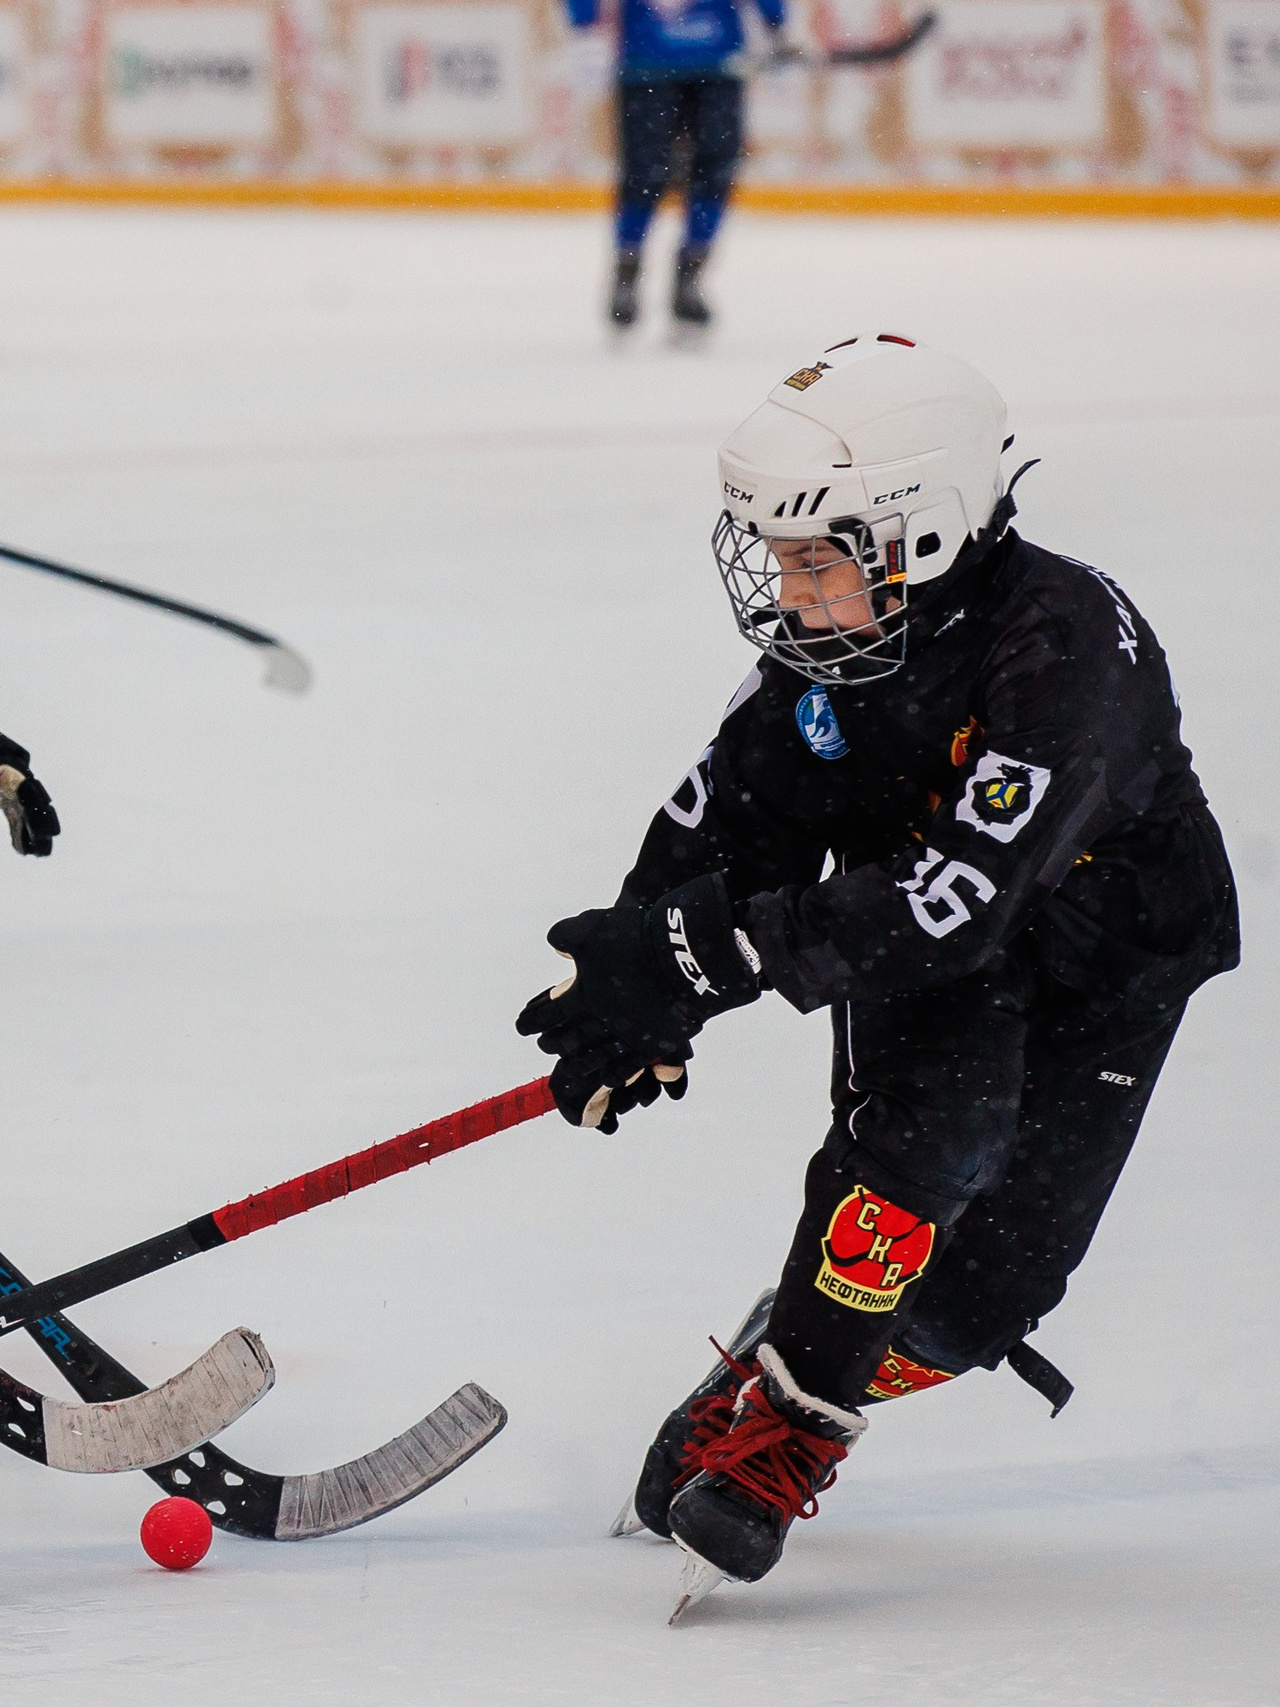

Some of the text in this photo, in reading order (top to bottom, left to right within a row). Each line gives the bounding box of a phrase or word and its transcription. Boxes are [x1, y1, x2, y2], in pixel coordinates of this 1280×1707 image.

[724, 480, 754, 504] CCM
[873, 483, 921, 505] CCM
[667, 907, 720, 997] STEX
[1097, 1071, 1137, 1087] STEX
[819, 1271, 898, 1309] НЕФТЯНИК
